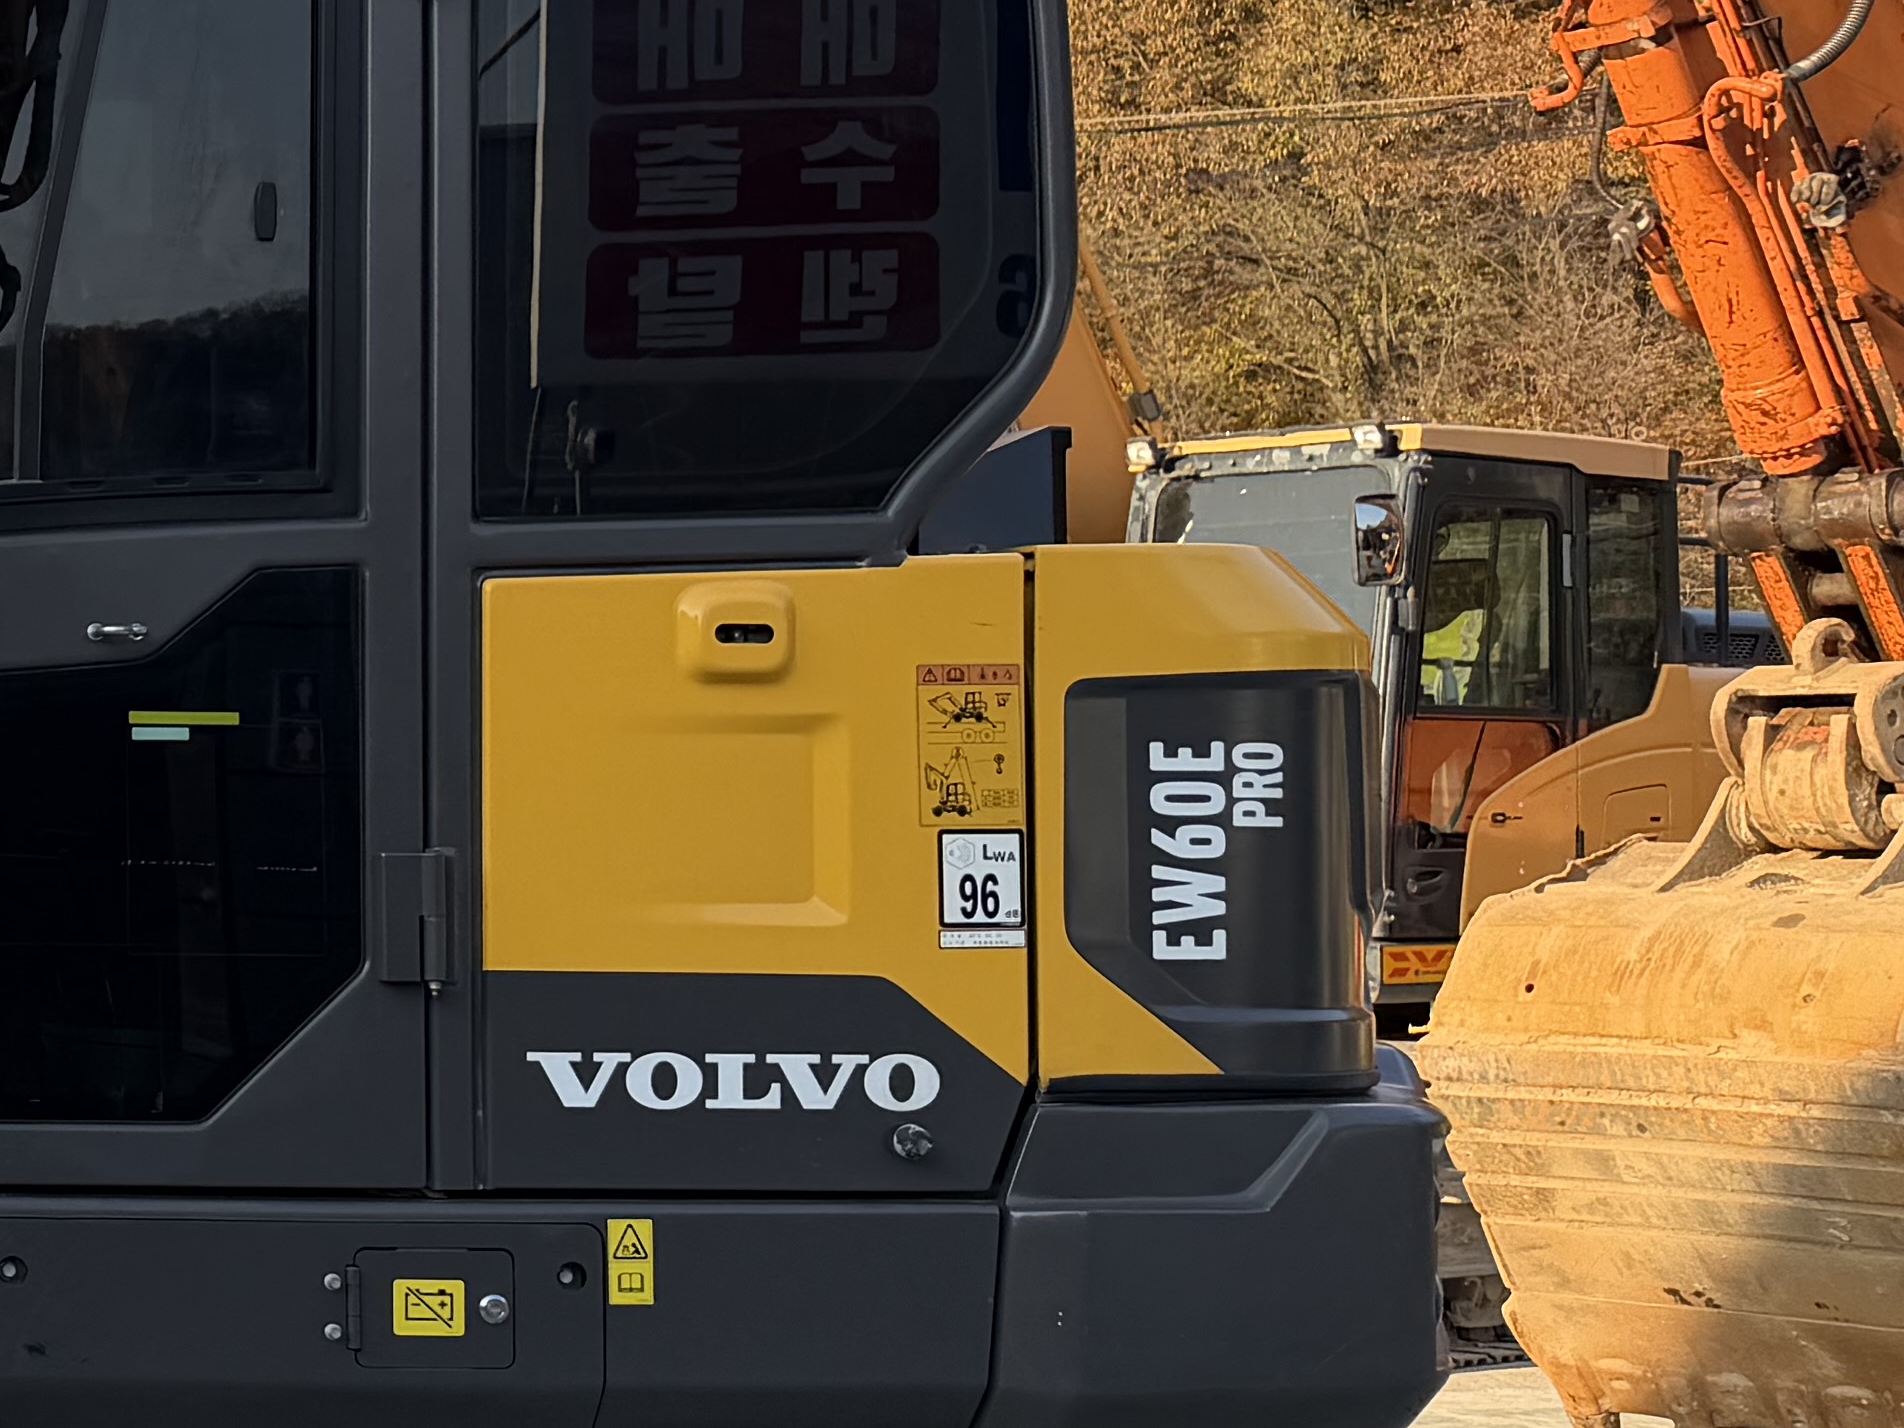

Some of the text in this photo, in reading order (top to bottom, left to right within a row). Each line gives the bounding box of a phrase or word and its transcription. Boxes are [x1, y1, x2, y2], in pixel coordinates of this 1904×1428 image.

[1231, 741, 1284, 828] PRO
[1149, 740, 1227, 961] EW60E
[958, 873, 1000, 919] 96
[525, 1049, 940, 1112] VOLVO
